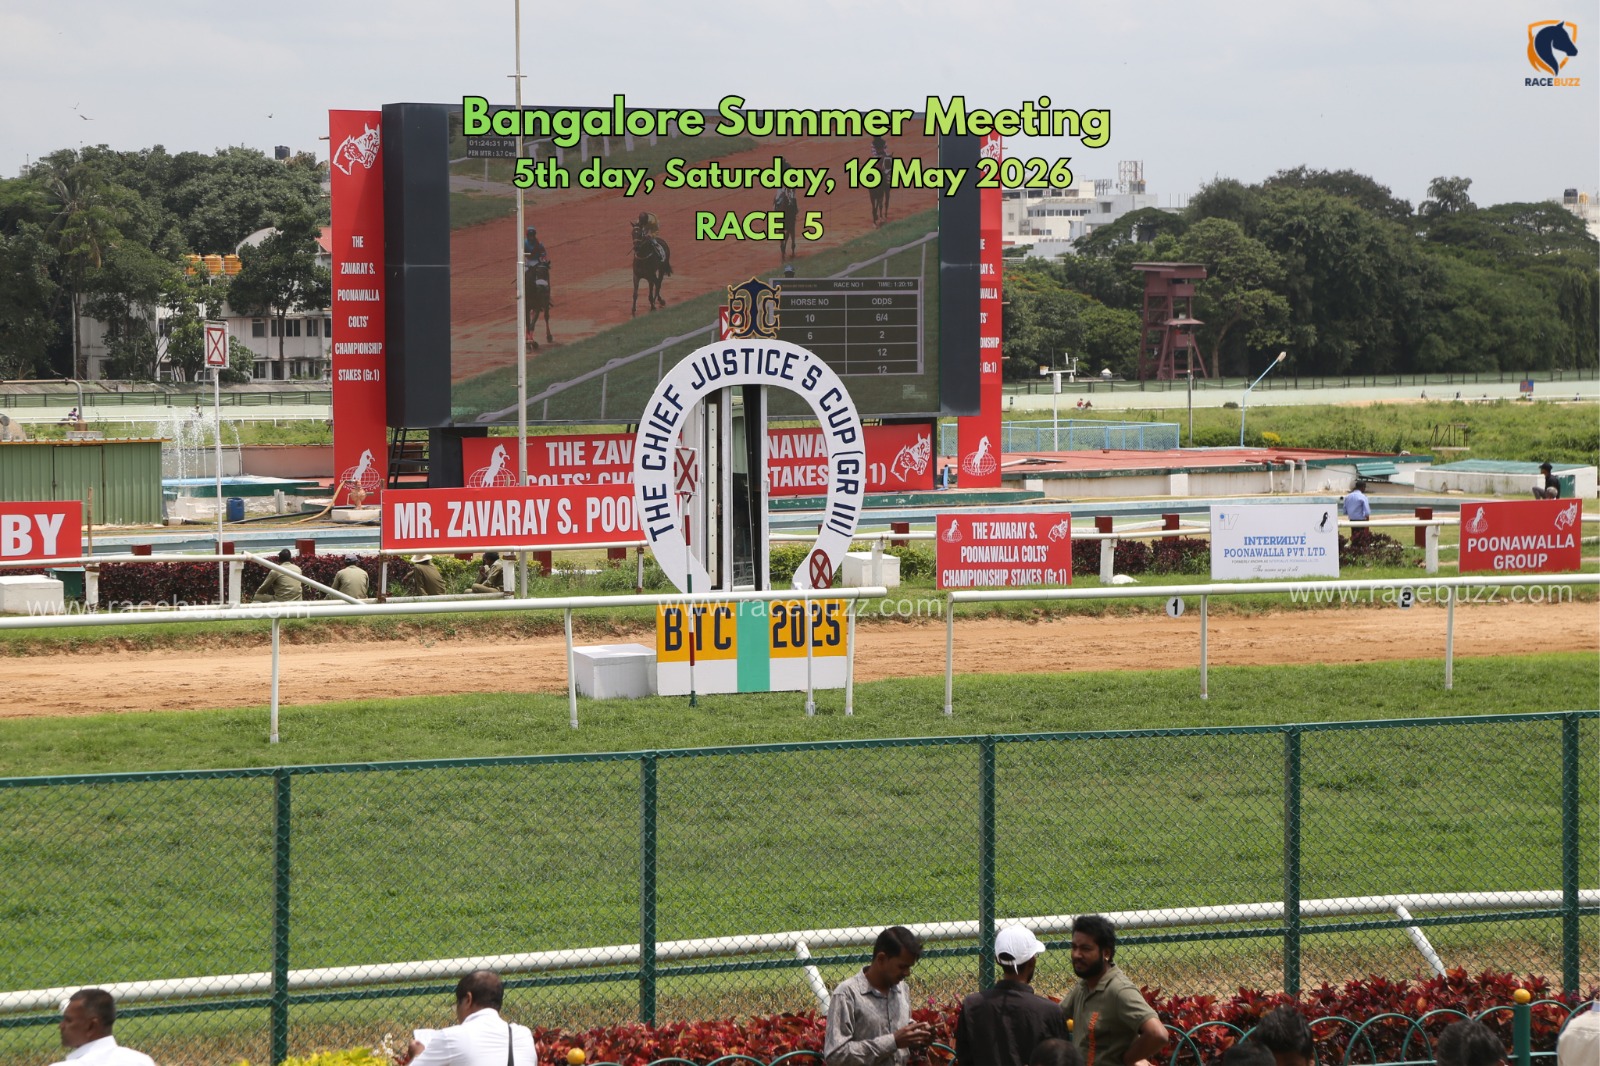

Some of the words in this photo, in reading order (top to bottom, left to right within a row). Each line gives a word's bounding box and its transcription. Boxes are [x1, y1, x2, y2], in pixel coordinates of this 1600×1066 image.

[352, 236, 364, 248] THE
[341, 262, 368, 274] ZAVARAY
[369, 262, 376, 274] S.
[337, 289, 380, 301] POONAWALLA
[790, 298, 816, 306] HORSE
[872, 297, 892, 306] ODDS
[348, 316, 369, 328] COLTS'
[805, 314, 815, 323] 10
[875, 313, 888, 322] 6/4
[807, 331, 813, 340] 6
[879, 331, 885, 339] 2
[335, 342, 383, 355] CHAMPIONSHIP
[877, 348, 887, 356] 12
[338, 369, 361, 381] STAKES
[363, 369, 380, 382] (Gr.1)
[691, 348, 823, 391] JUSTICE'S
[877, 365, 887, 374] 12
[819, 387, 857, 445] CUP
[641, 383, 684, 472] CHIEF
[546, 441, 586, 467] THE
[592, 439, 634, 465] ZAV
[831, 450, 864, 495] (GR
[394, 502, 440, 540] MR.
[447, 499, 550, 538] ZAVARAY
[557, 497, 578, 534] S.
[642, 483, 675, 542] THE
[1, 513, 66, 557] BY
[972, 522, 988, 540] THE
[989, 522, 1027, 540] ZAVARAY
[1029, 522, 1038, 539] S.
[1244, 535, 1306, 545] INTERVALVE
[1467, 533, 1575, 552] POONAWALLA
[960, 545, 1020, 563] POONAWALLA
[1021, 545, 1049, 562] COLTS'
[1224, 547, 1285, 558] POONAWALLA
[1493, 553, 1548, 570] GROUP
[942, 568, 1008, 587] CHAMPIONSHIP
[1010, 568, 1042, 585] STAKES
[1044, 568, 1067, 586] (Gr.1)
[1401, 591, 1411, 607] 2
[1172, 599, 1178, 615] 1
[772, 604, 840, 648] 2025
